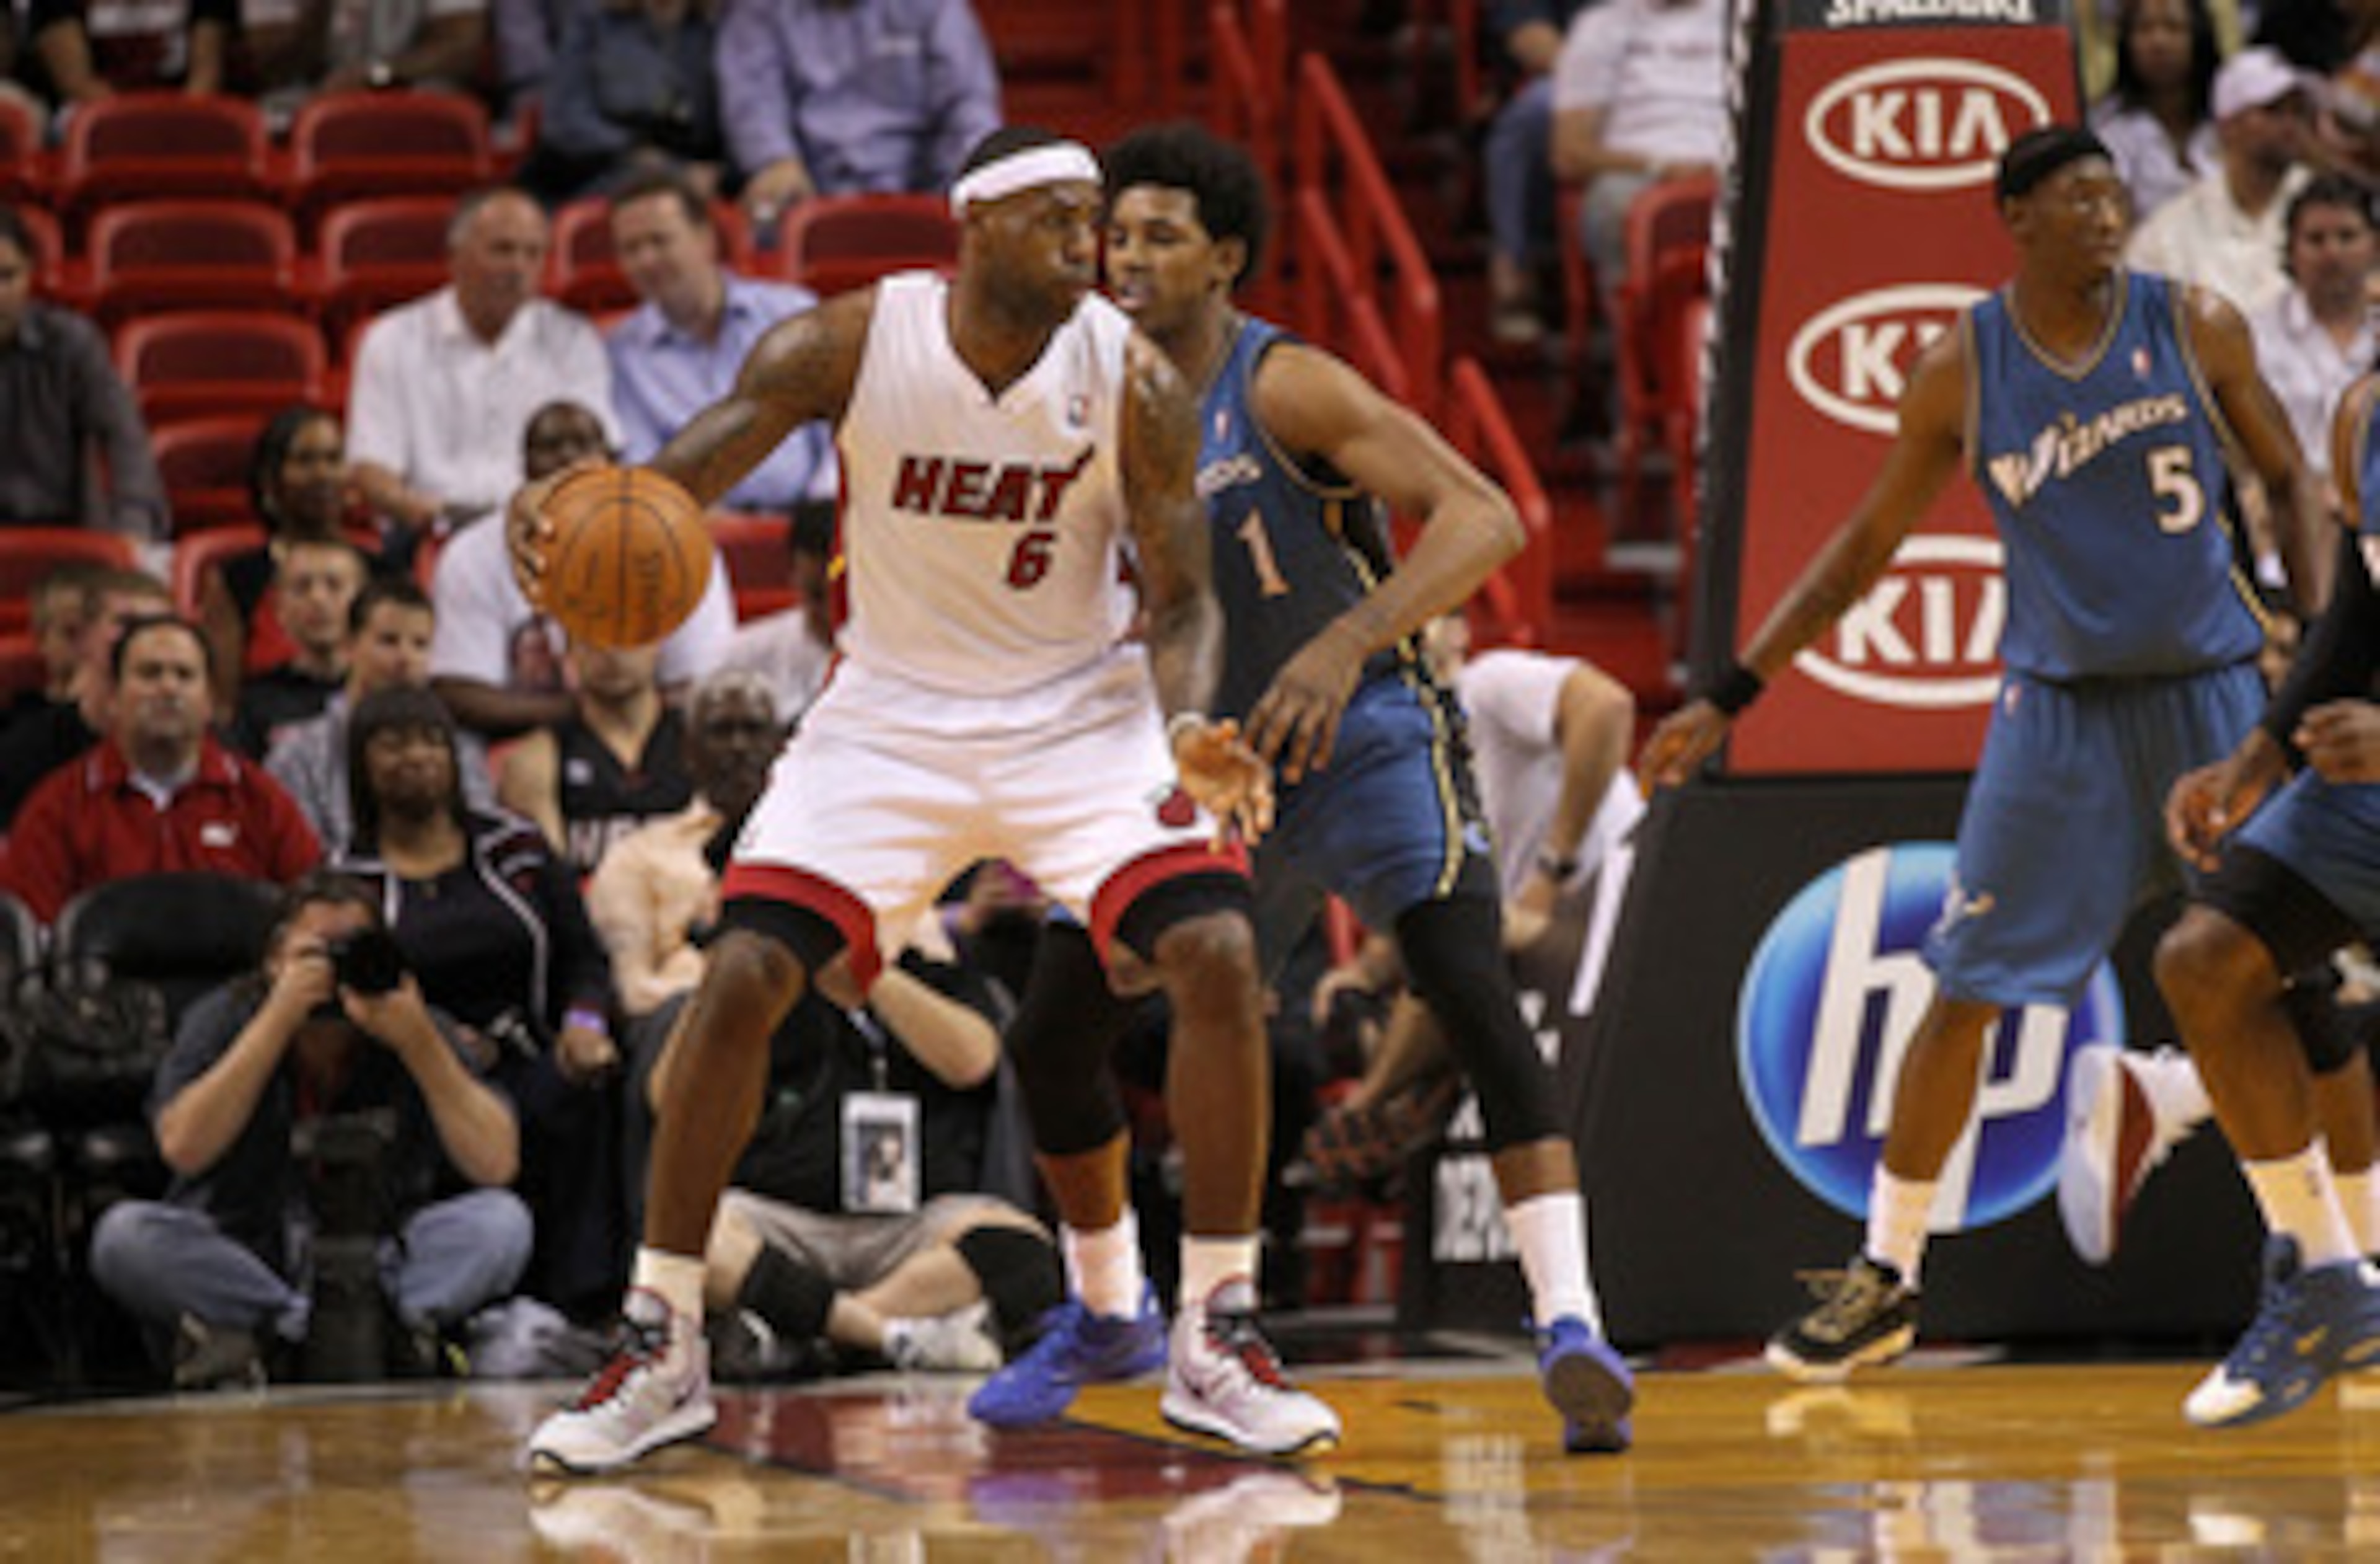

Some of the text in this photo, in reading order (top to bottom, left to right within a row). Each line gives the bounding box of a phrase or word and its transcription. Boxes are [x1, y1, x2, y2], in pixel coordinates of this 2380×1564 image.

[1852, 88, 2008, 159] KIA
[892, 443, 1095, 522] HEAT
[2147, 445, 2205, 533] 5
[1006, 532, 1057, 589] 6
[1235, 508, 1290, 596] 1
[1797, 848, 2070, 1234] hp
